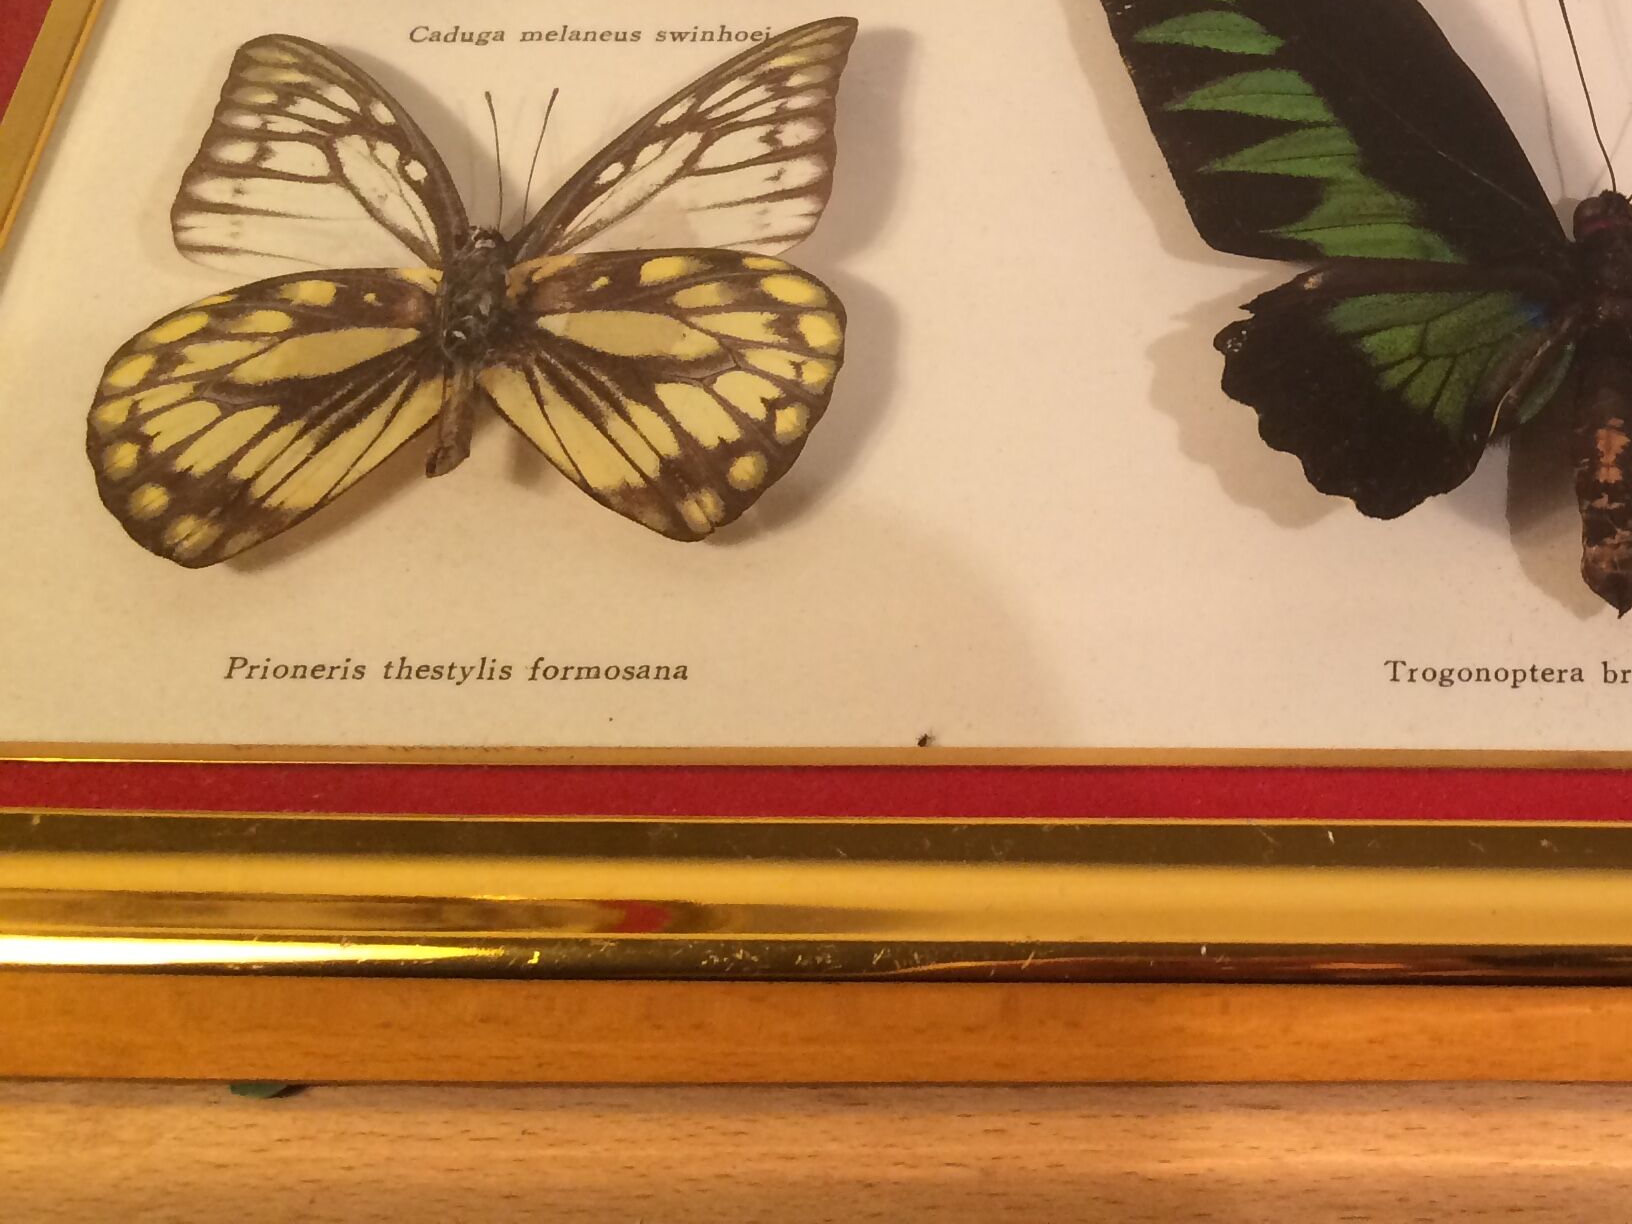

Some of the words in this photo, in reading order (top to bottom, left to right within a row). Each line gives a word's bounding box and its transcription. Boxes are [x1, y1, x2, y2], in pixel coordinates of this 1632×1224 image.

[408, 25, 506, 46] Caduga
[519, 24, 642, 43] melaneus
[224, 657, 367, 680] Prioneris
[383, 657, 513, 685] thestylis
[527, 657, 689, 682] formosana
[1384, 660, 1585, 688] Trogonoptera
